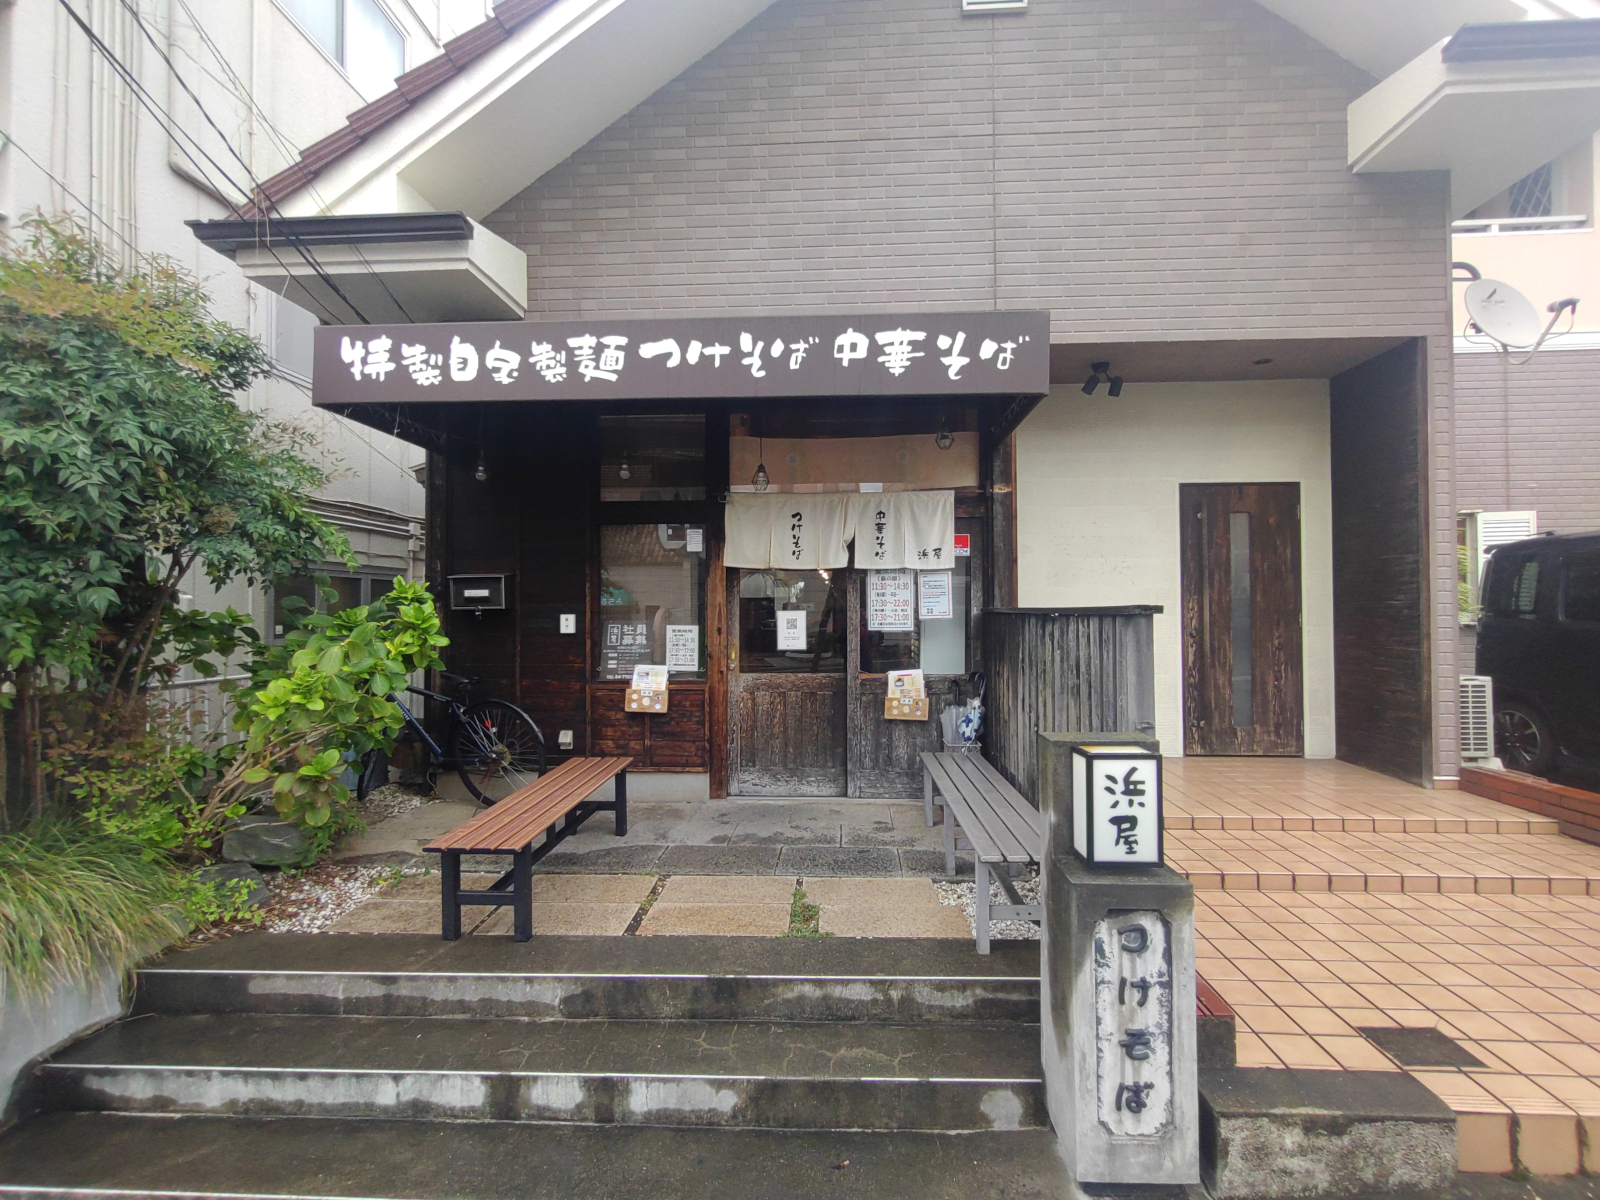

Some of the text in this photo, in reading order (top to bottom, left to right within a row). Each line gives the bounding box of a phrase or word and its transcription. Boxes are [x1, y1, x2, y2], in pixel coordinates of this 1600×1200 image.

[340, 328, 1030, 386] 特製自家製麺 つけそば 中華そば
[790, 511, 804, 561] つけそば
[874, 510, 888, 560] 中華そば
[917, 547, 942, 560] 浜屋
[622, 624, 647, 635] 社員
[1104, 767, 1147, 855] 浜屋
[1115, 923, 1154, 1114] つけそば
